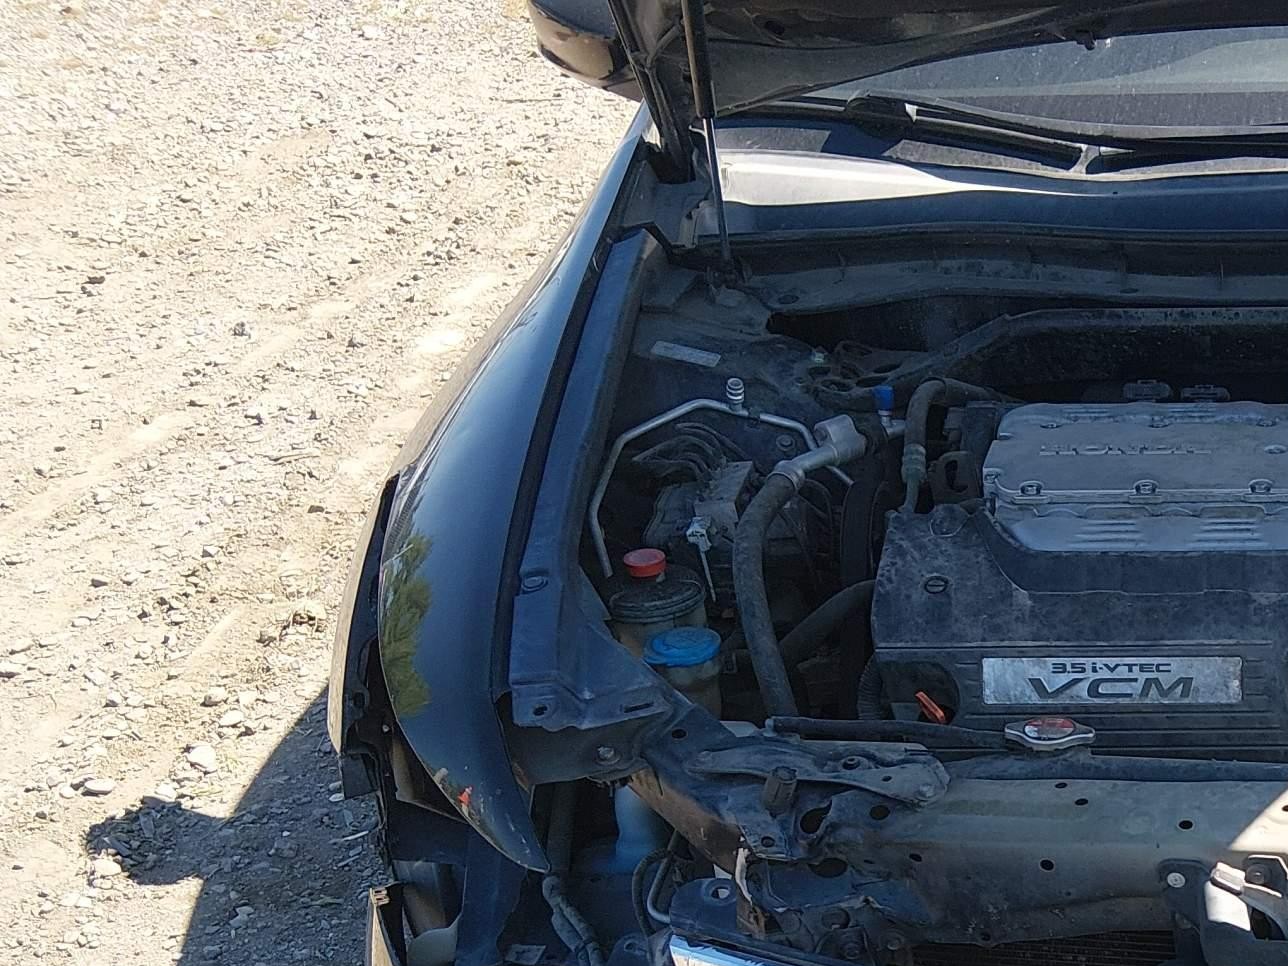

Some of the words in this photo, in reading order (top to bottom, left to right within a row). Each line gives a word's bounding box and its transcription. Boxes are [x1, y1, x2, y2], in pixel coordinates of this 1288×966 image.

[1051, 662, 1086, 674] 3.5
[1091, 662, 1172, 674] i-VTEC
[1026, 676, 1194, 699] VCM
